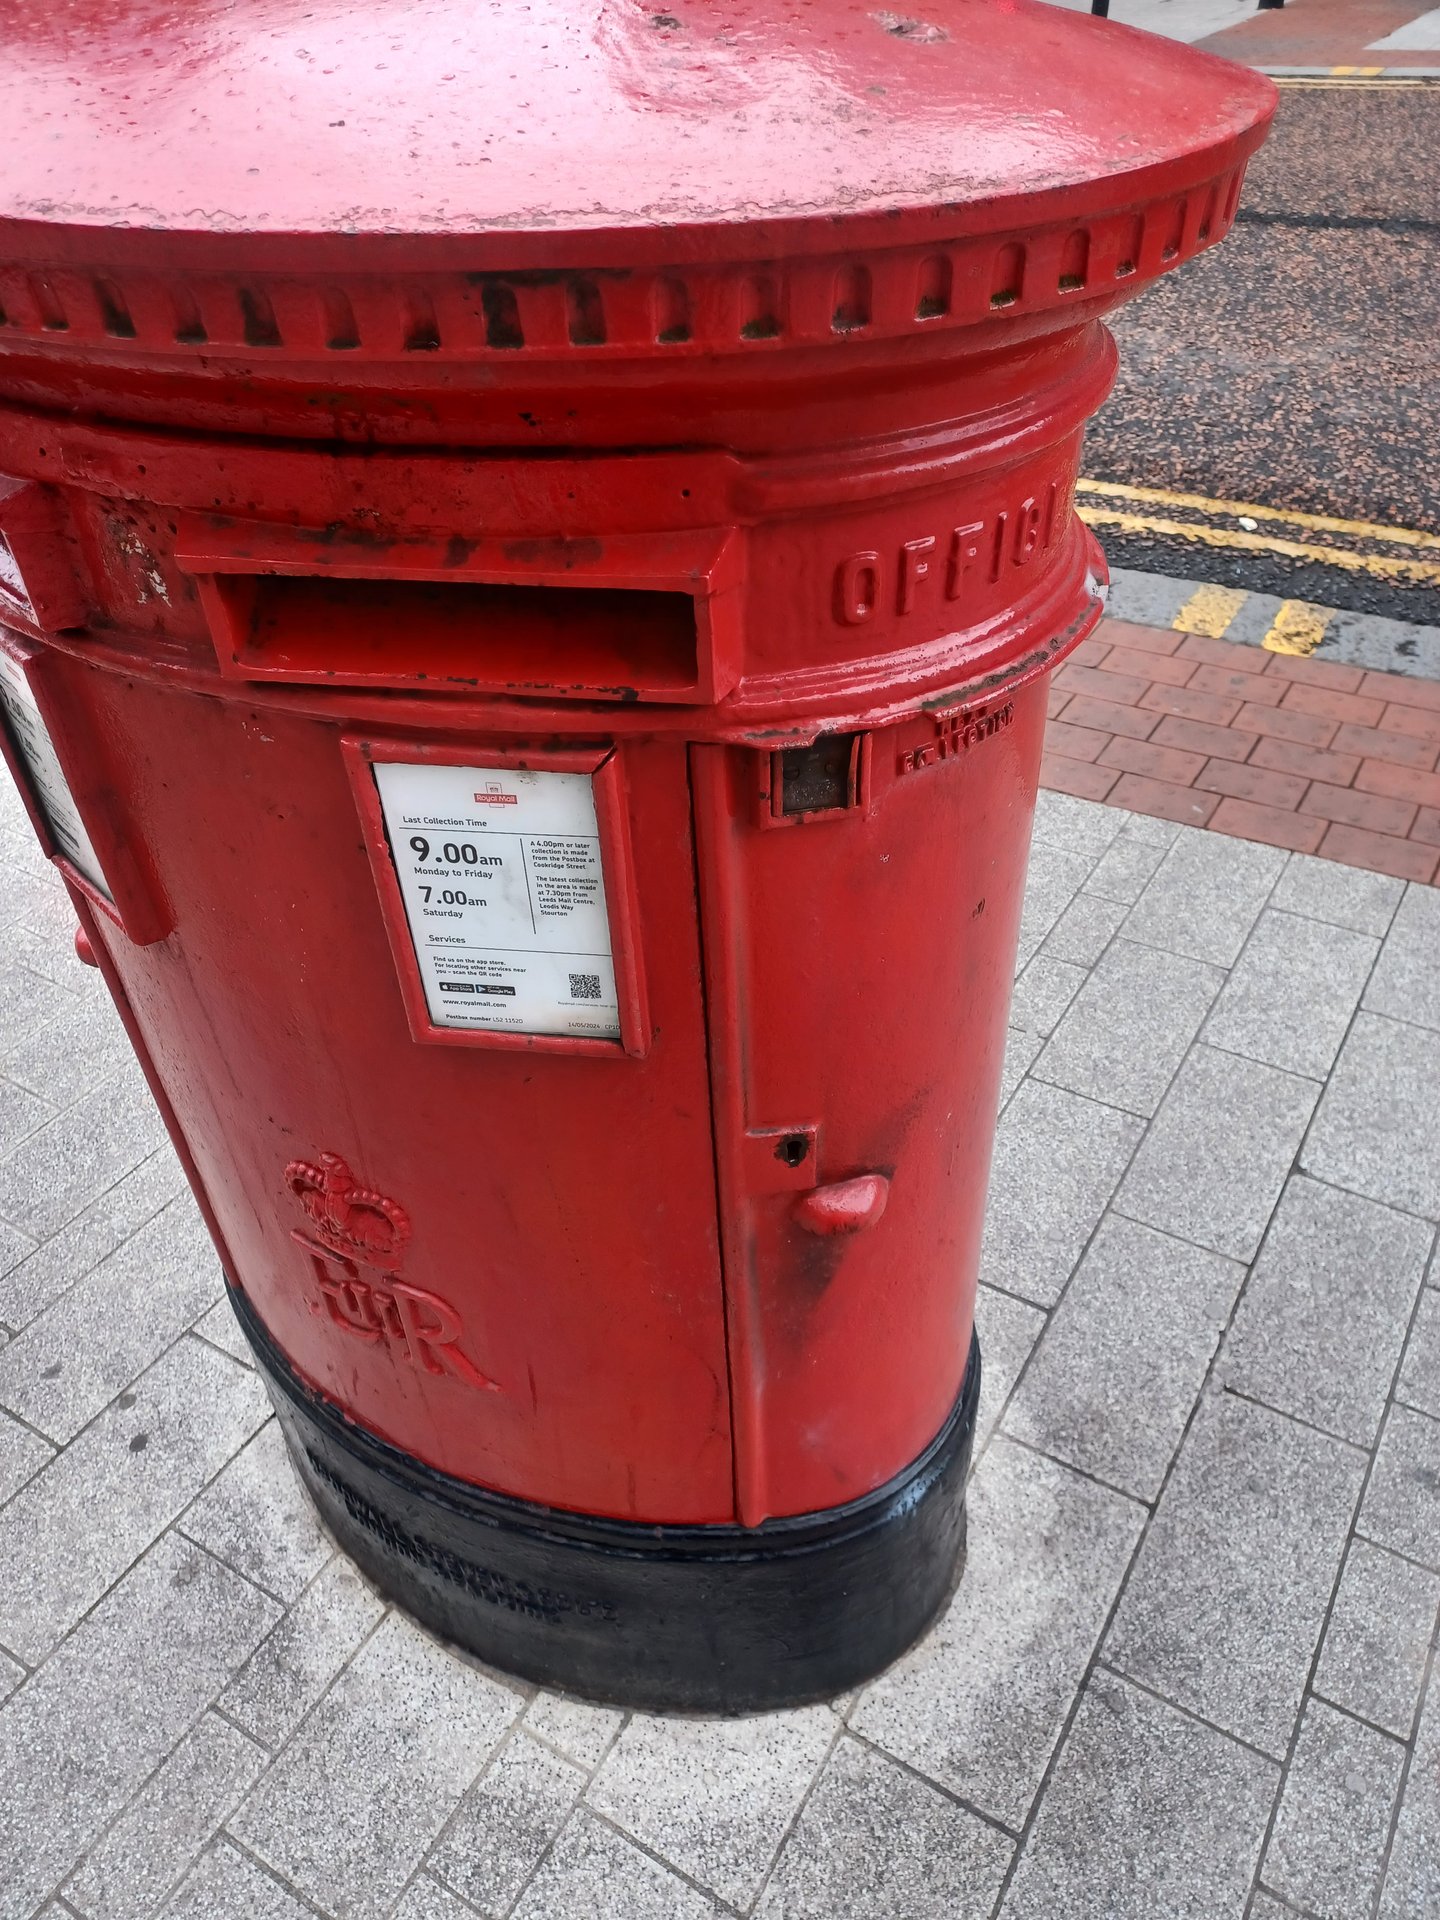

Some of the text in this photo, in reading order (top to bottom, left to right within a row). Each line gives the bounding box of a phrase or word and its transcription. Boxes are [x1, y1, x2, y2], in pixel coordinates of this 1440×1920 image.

[476, 794, 516, 803] Royal Mail
[403, 816, 487, 827] Last Collection Time
[536, 840, 564, 848] 4.00pm
[409, 836, 503, 866] 9.00am
[414, 867, 449, 877] Monday
[465, 870, 493, 879] Friday
[418, 886, 487, 907] 7.00am
[423, 908, 463, 918] Saturday
[429, 934, 466, 943] Services
[442, 999, 507, 1008] www.royalmail.com
